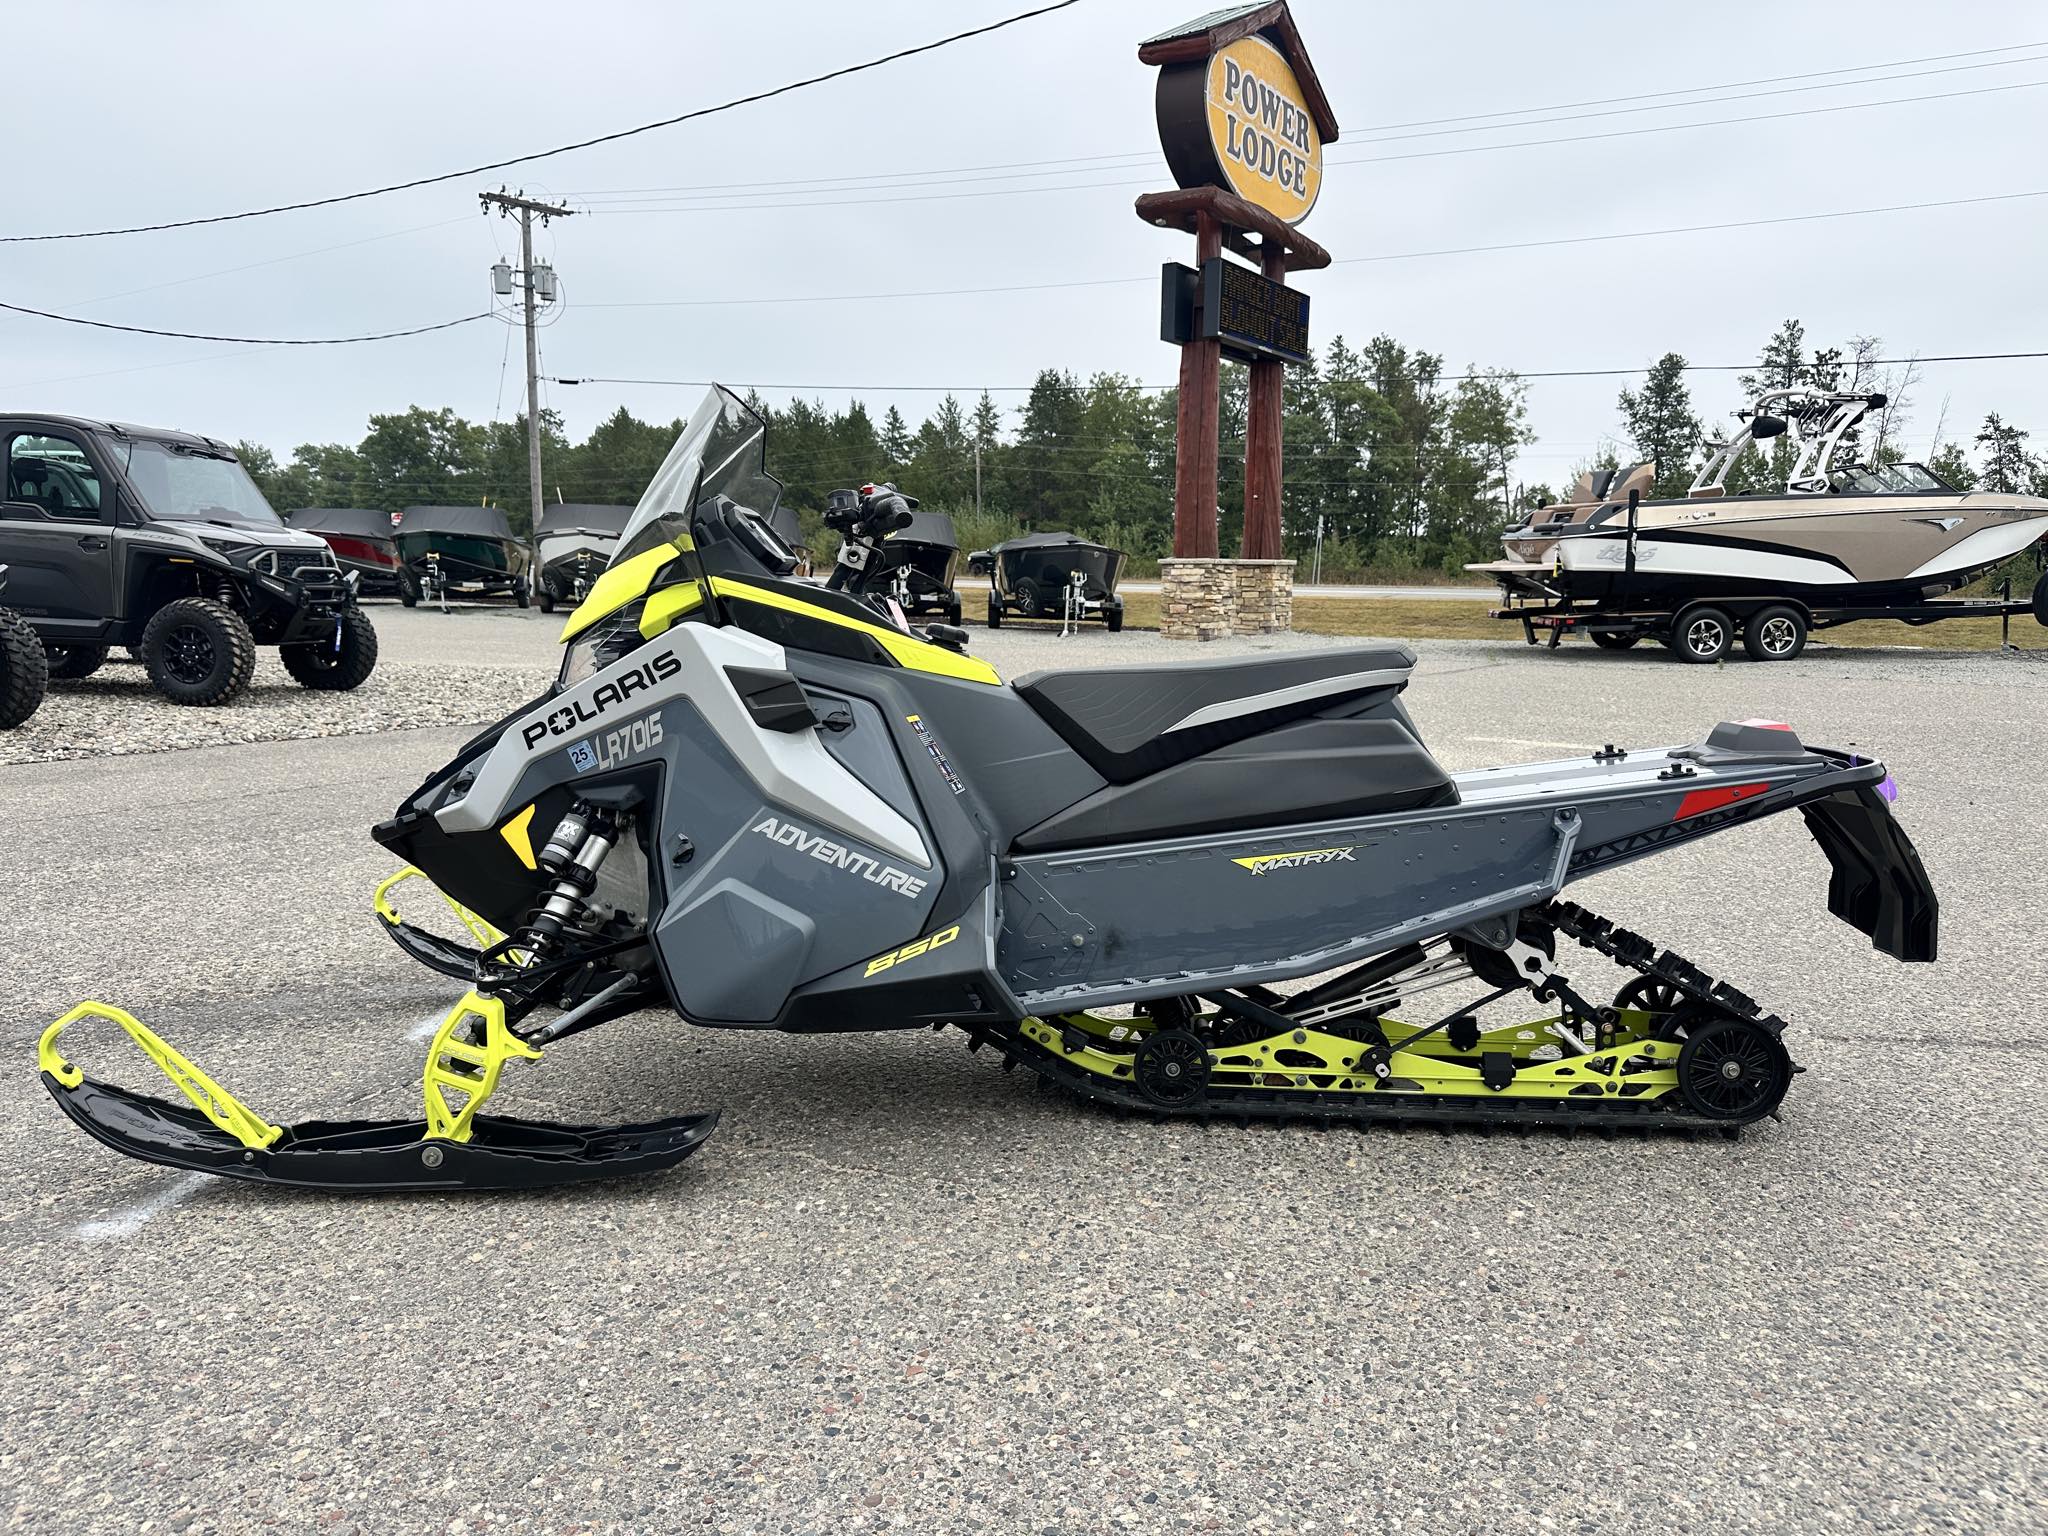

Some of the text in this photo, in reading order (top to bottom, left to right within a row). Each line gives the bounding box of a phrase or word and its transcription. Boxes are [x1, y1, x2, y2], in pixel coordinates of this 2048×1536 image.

[1225, 58, 1310, 153] POWER
[1227, 113, 1306, 198] LODGE
[522, 650, 682, 751] POLARIS
[571, 747, 588, 765] 25
[595, 711, 664, 770] LR7015
[752, 817, 929, 899] ADVENTURE
[1251, 846, 1357, 876] MATRYX
[864, 925, 960, 978] 850
[109, 1109, 221, 1147] POLARIS
